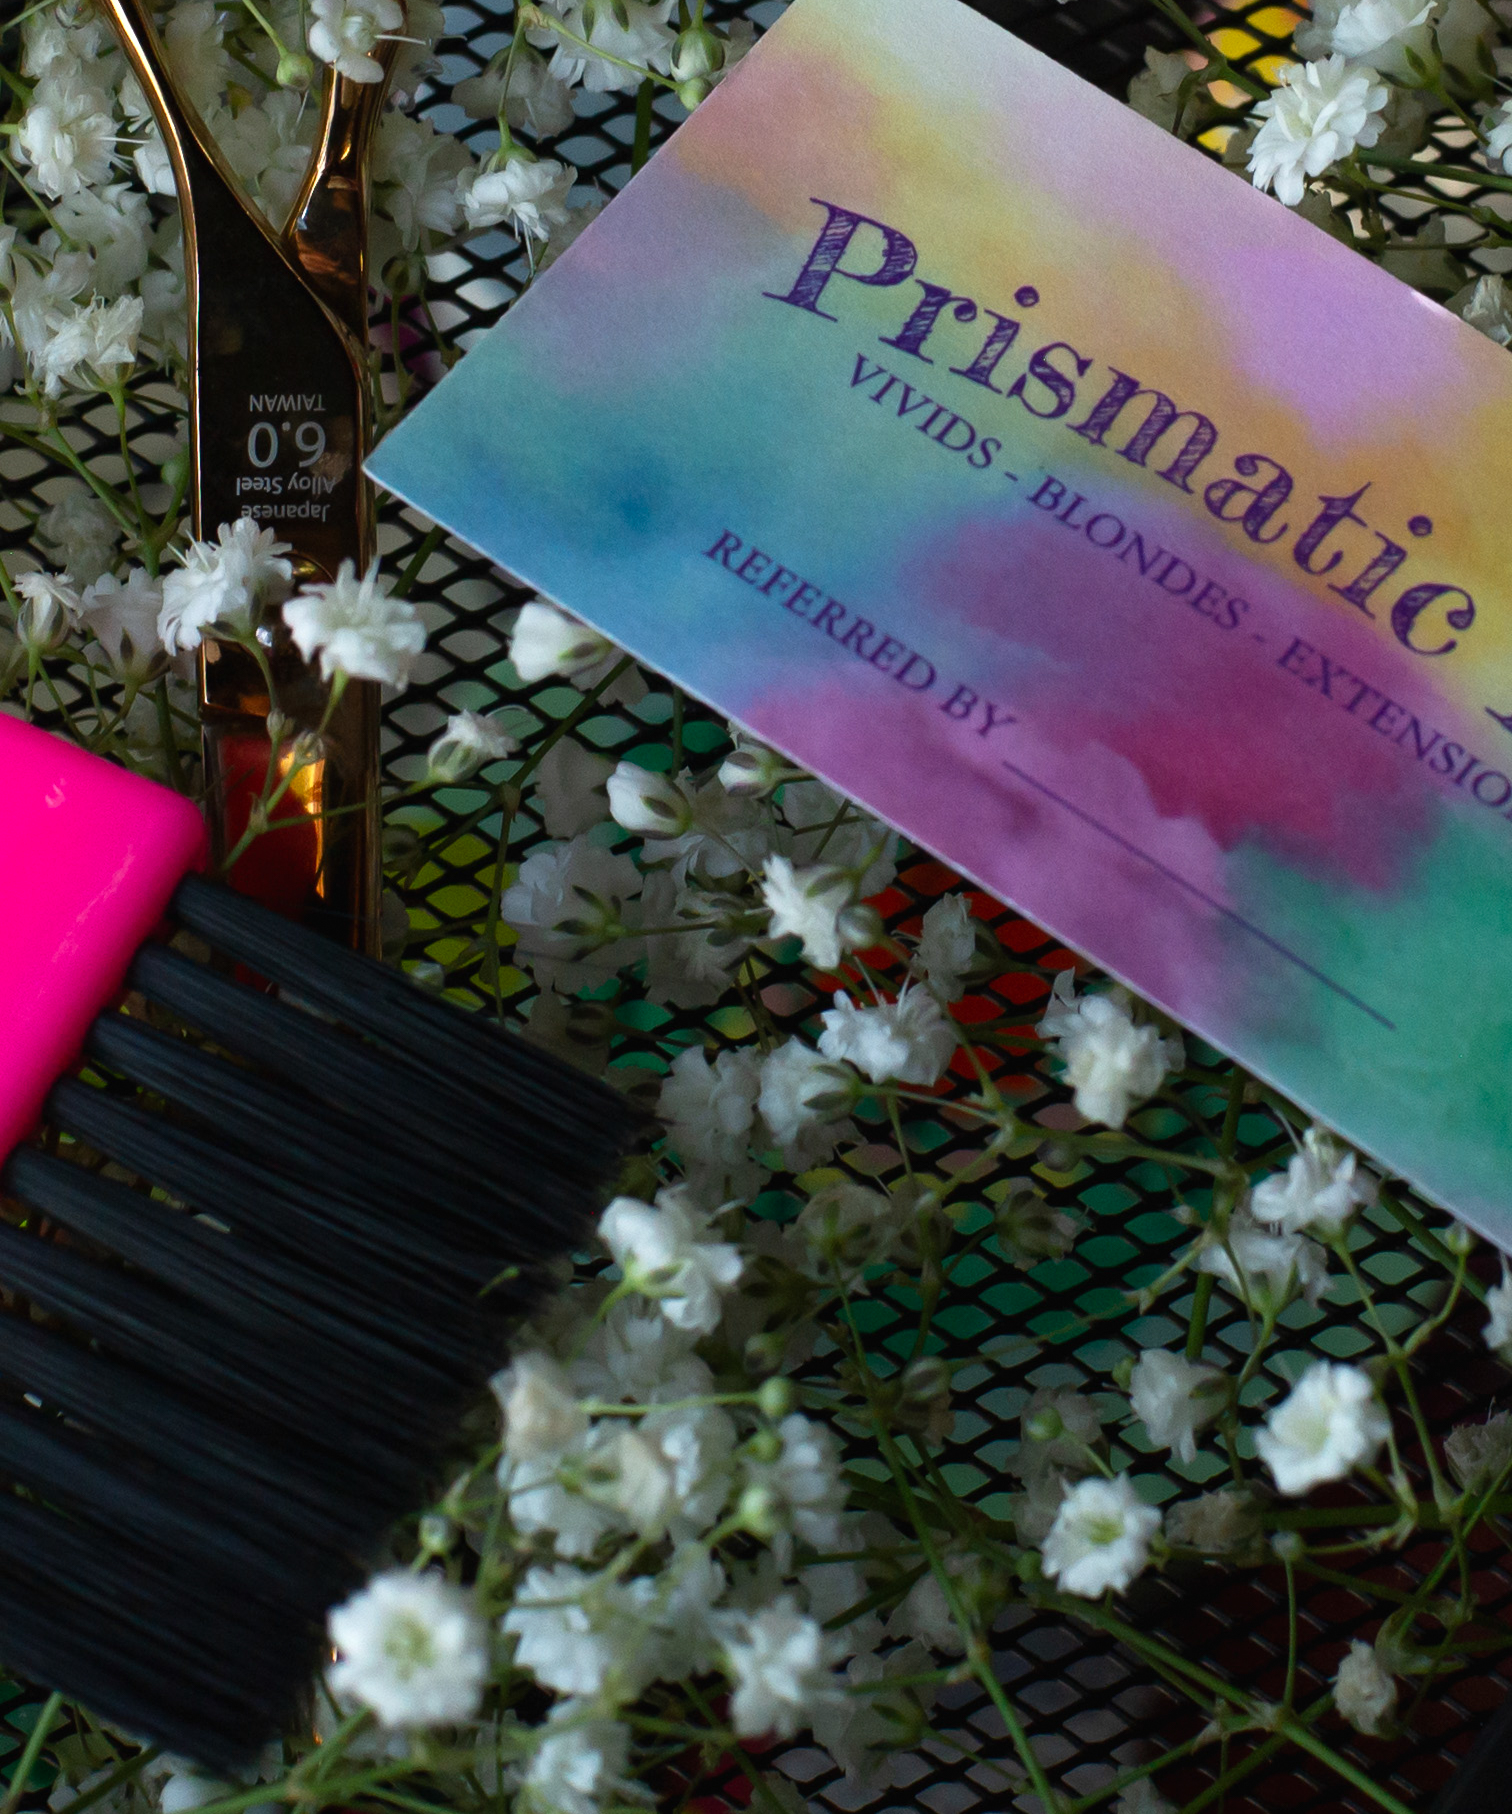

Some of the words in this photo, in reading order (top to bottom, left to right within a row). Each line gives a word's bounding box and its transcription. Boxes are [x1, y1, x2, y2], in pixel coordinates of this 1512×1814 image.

[250, 394, 326, 411] TAIWAN
[763, 197, 1475, 657] Prismatic
[247, 421, 326, 469] 6.0
[236, 477, 282, 495] Steel
[288, 472, 338, 494] Alloy
[846, 354, 1002, 472] VIVIDS
[1026, 474, 1250, 631] BLONDES
[241, 501, 330, 522] Japanese
[703, 530, 940, 696] REFERRED
[938, 680, 1015, 740] BY
